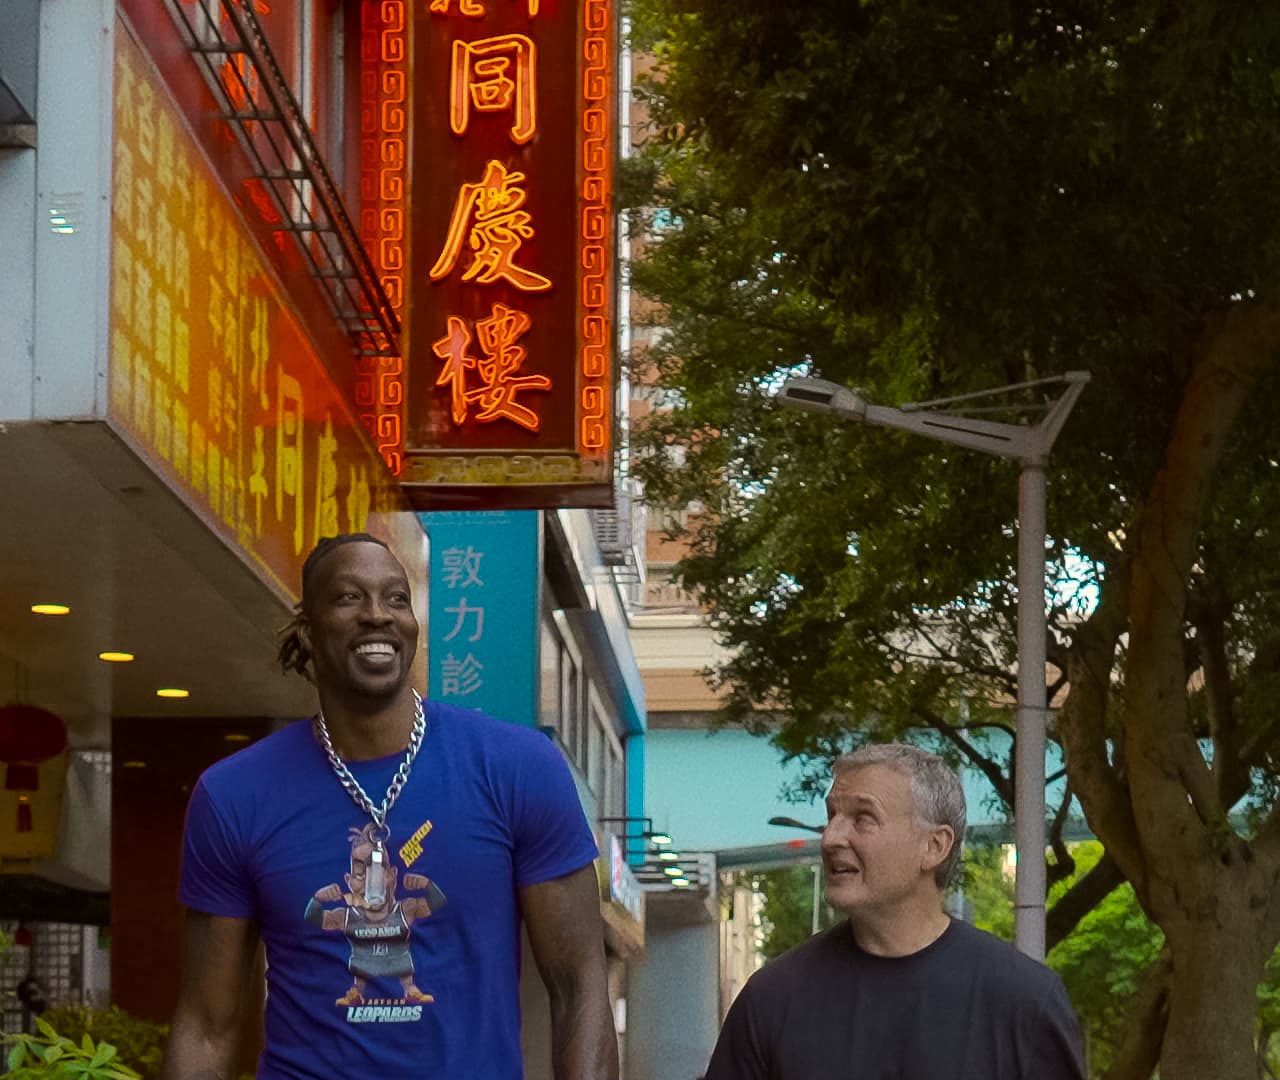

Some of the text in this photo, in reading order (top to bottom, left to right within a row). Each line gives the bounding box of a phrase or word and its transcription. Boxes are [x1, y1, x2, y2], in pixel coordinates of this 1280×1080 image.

[430, 33, 553, 432] 同慶樓
[440, 544, 485, 711] 敦力診
[354, 926, 401, 938] LEOPARDS
[346, 1005, 423, 1023] LEOPARDS
